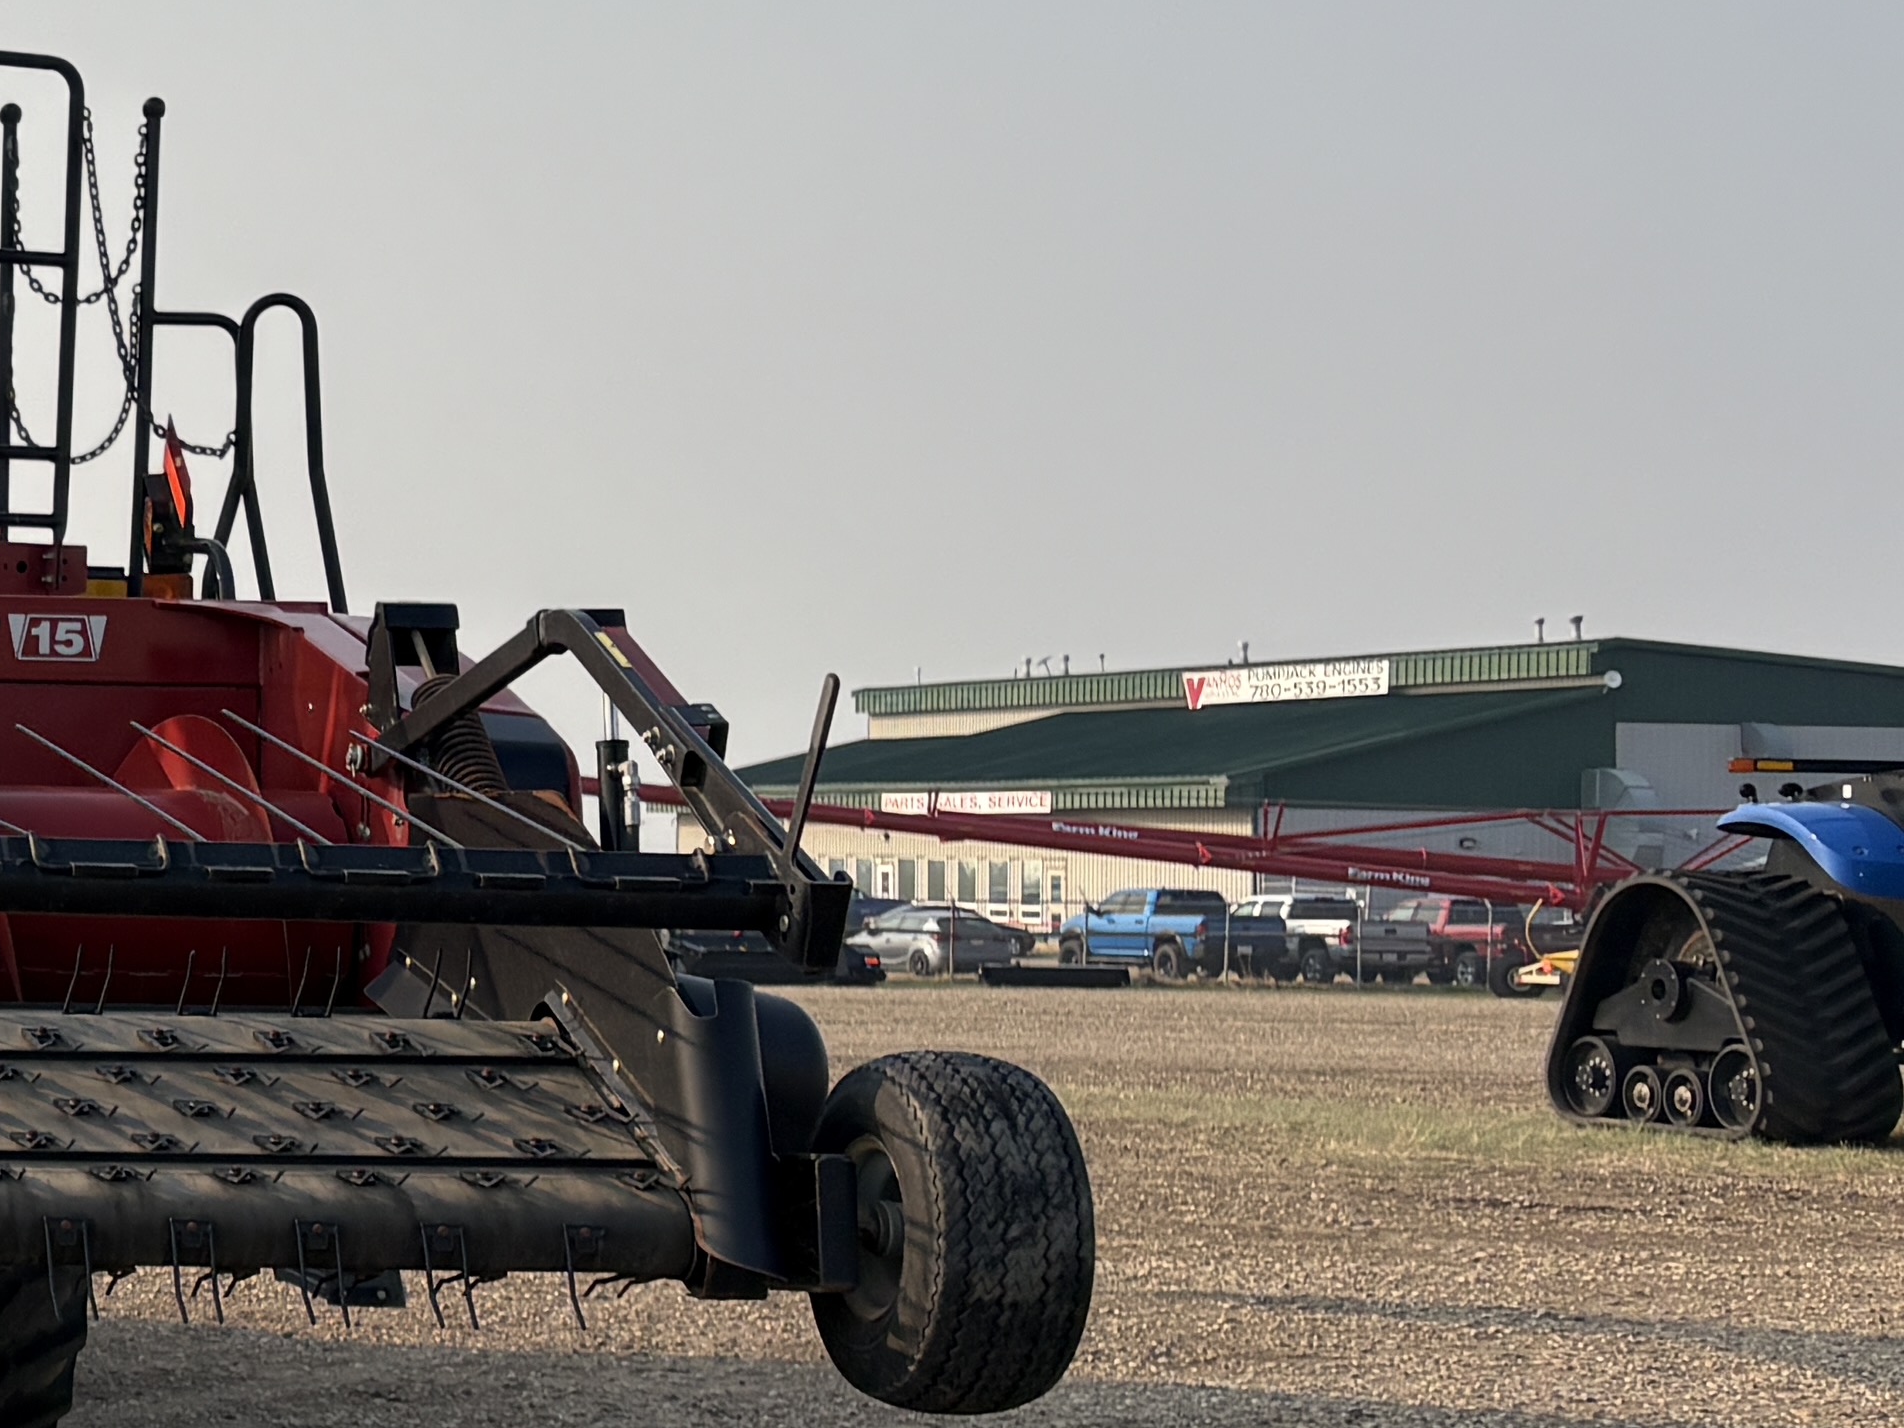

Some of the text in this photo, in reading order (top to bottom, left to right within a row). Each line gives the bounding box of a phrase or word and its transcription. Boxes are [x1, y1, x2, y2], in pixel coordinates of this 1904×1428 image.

[31, 620, 85, 656] 15
[1248, 676, 1382, 702] 780-539-1553
[988, 792, 1049, 809] SERVICE
